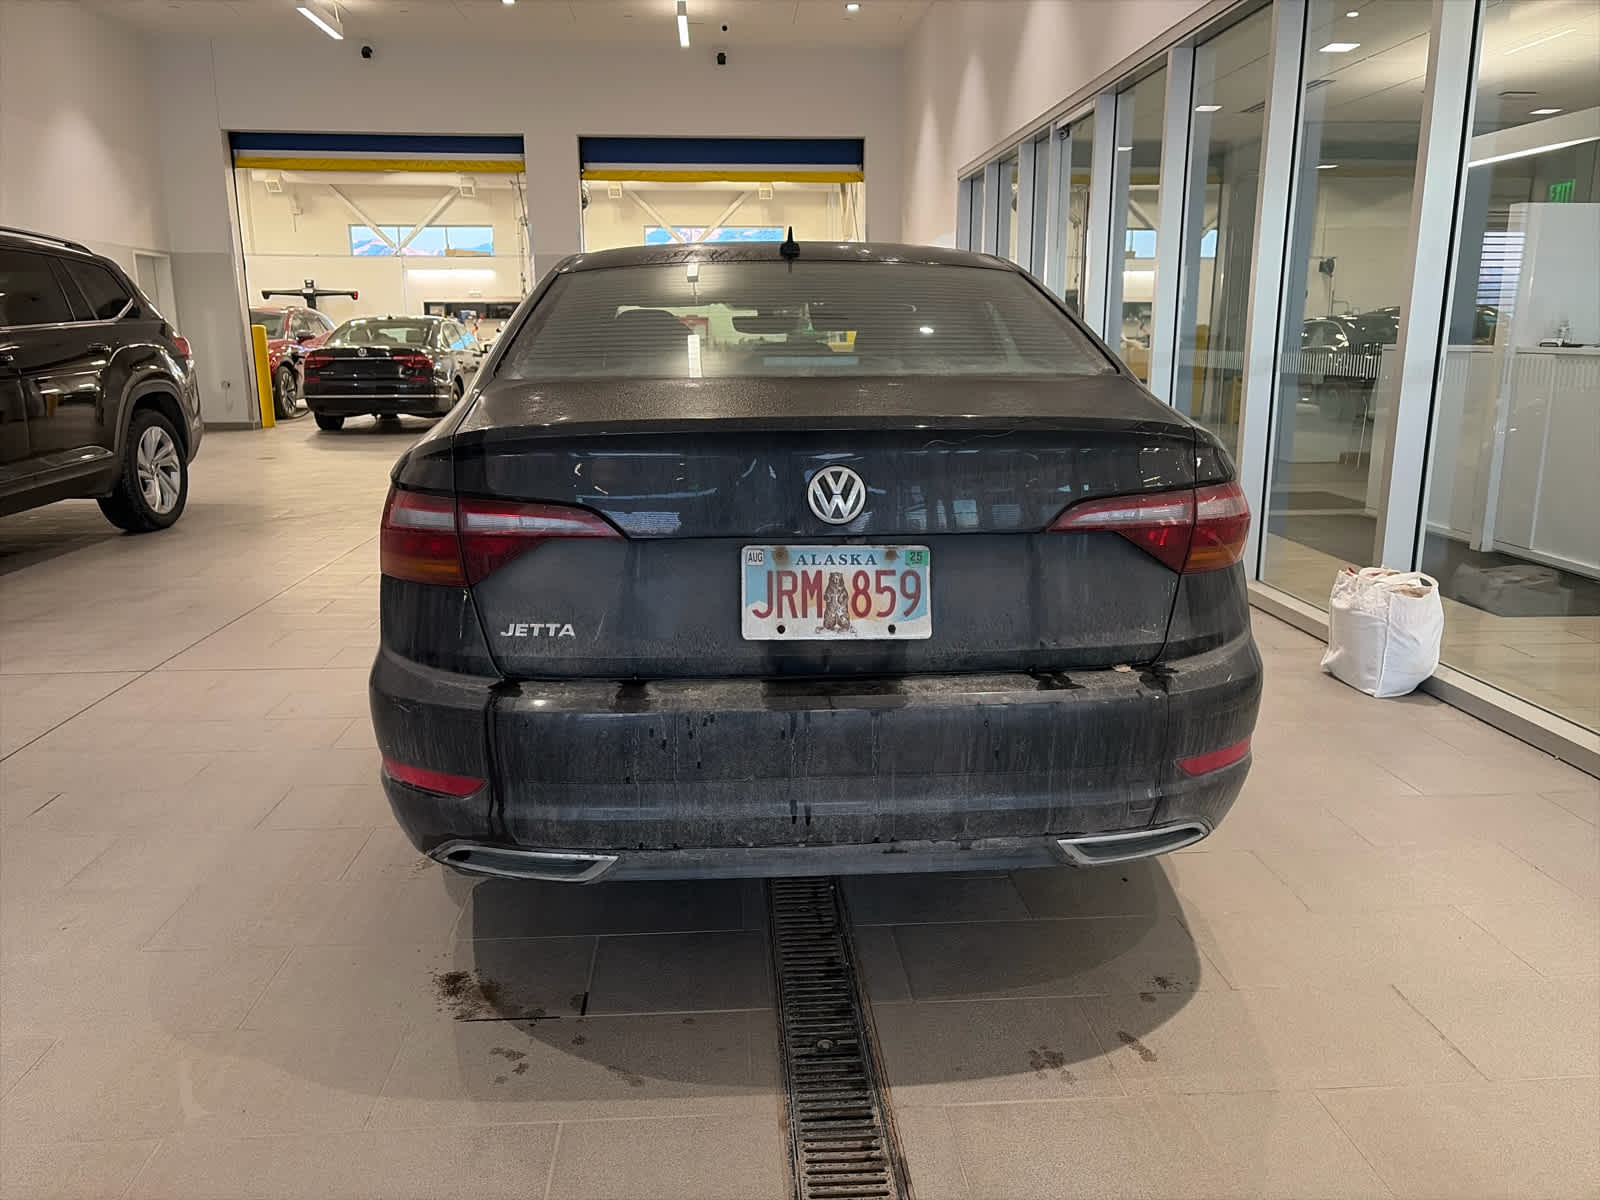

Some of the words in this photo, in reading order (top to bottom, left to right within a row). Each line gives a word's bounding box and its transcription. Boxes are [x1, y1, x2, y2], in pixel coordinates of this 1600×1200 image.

[807, 466, 867, 525] VW
[747, 551, 764, 563] AUG
[795, 553, 878, 567] ALASKA
[909, 551, 923, 562] 25
[752, 569, 824, 619] JRM
[851, 569, 922, 619] 859
[500, 623, 576, 638] JETTA
